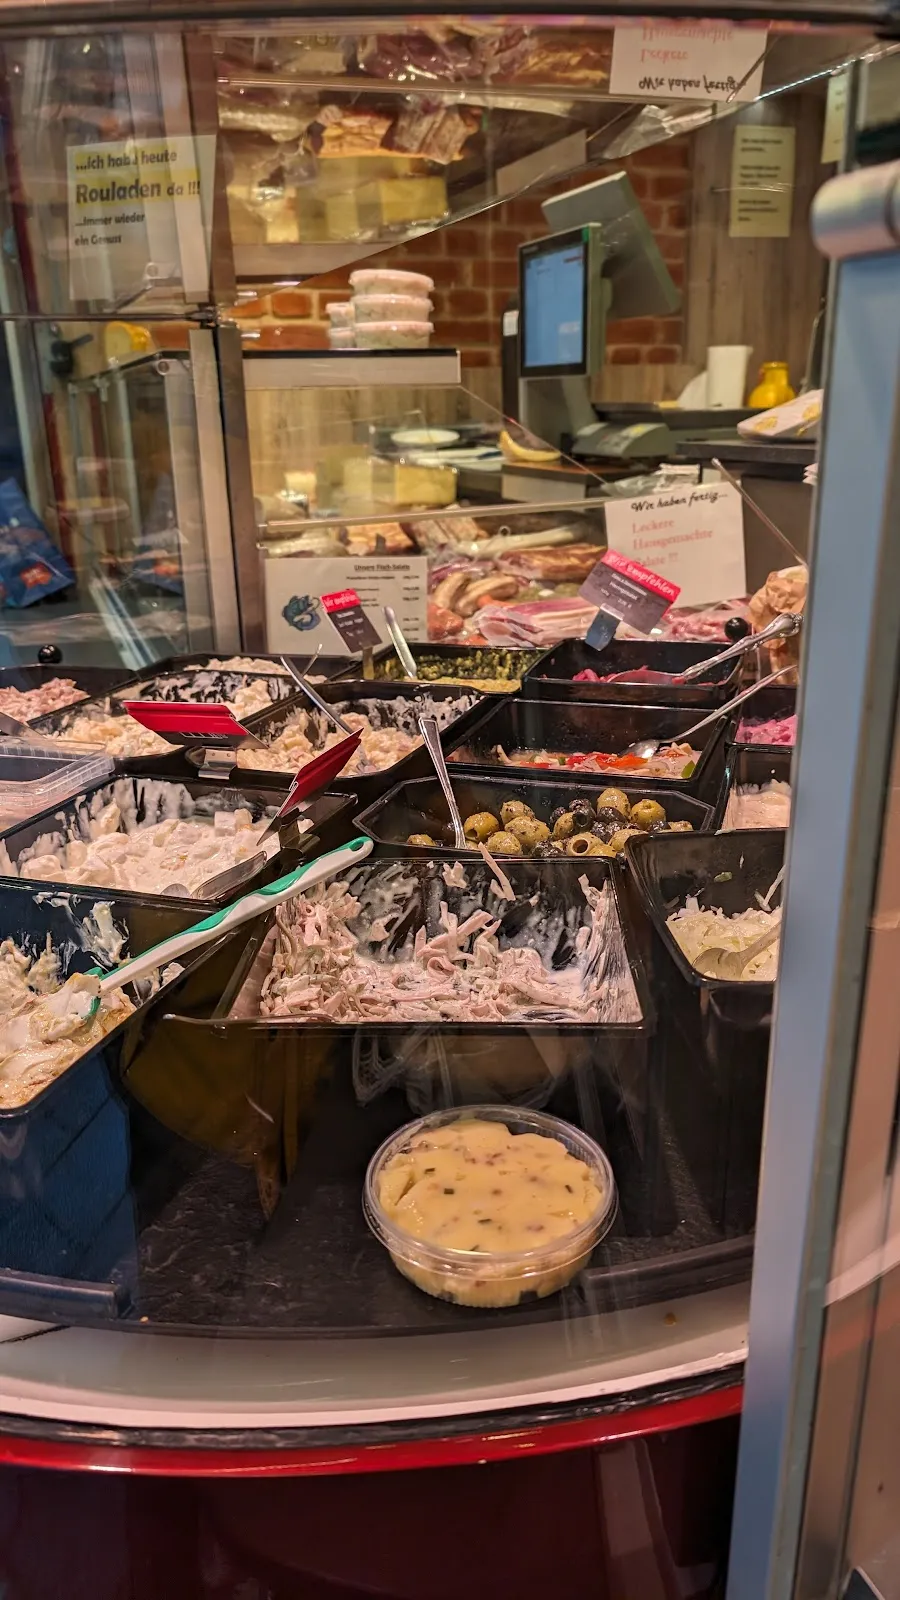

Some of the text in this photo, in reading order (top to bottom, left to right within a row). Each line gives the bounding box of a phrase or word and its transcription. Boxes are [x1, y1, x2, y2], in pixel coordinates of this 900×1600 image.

[141, 149, 178, 165] heute
[76, 178, 162, 204] Rouladen
[166, 182, 184, 196] da
[115, 212, 145, 224] wieder
[74, 235, 89, 247] ein
[631, 501, 655, 512] Wir
[656, 497, 687, 508] haben
[632, 519, 675, 534] Leckere
